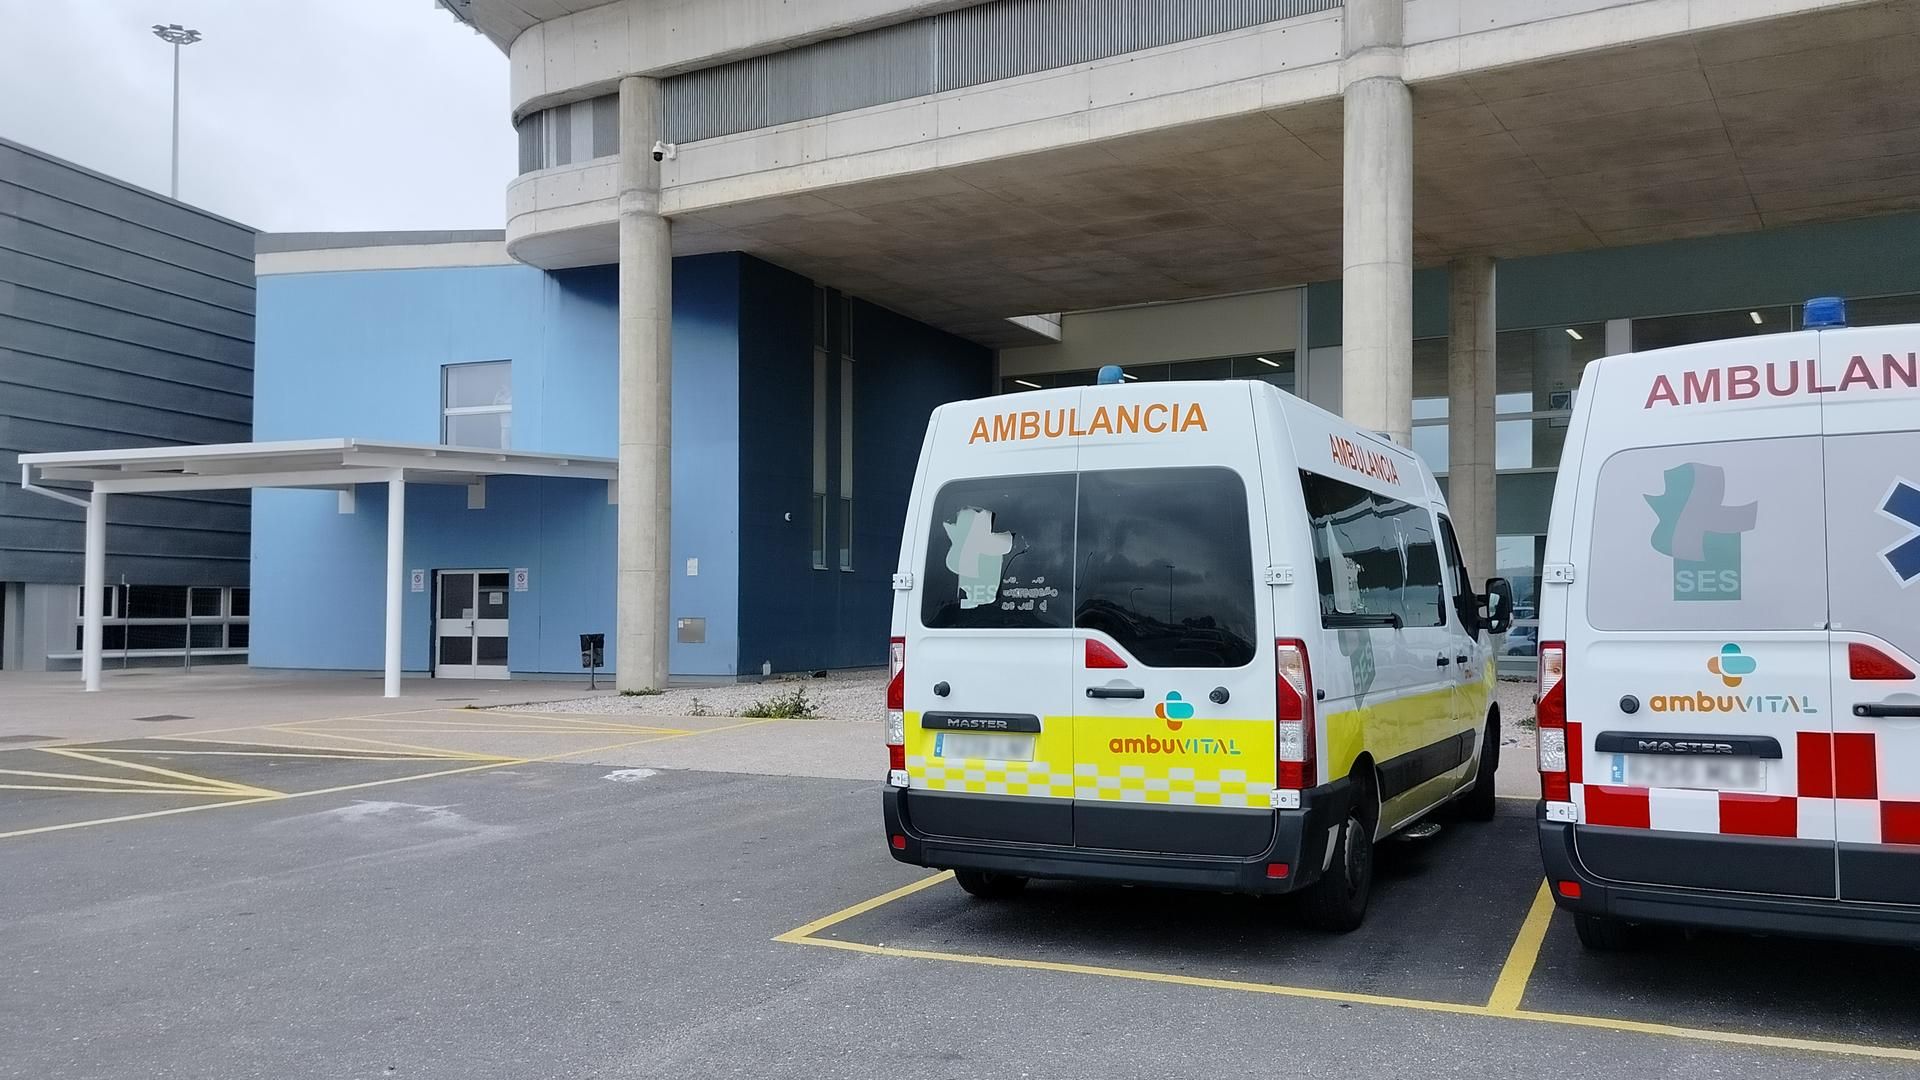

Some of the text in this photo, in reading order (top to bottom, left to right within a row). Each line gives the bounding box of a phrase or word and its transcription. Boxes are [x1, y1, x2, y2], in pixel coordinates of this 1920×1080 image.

[1643, 352, 1919, 409] AMBULAN
[968, 402, 1208, 445] AMBULANCIA
[1328, 432, 1401, 487] AMBULANCIA
[1676, 569, 1739, 593] SES
[1650, 690, 1818, 714] ambuVITAL
[947, 718, 1008, 729] MASTER
[1109, 734, 1242, 754] ambuVITAL
[1638, 740, 1733, 754] MASTER
